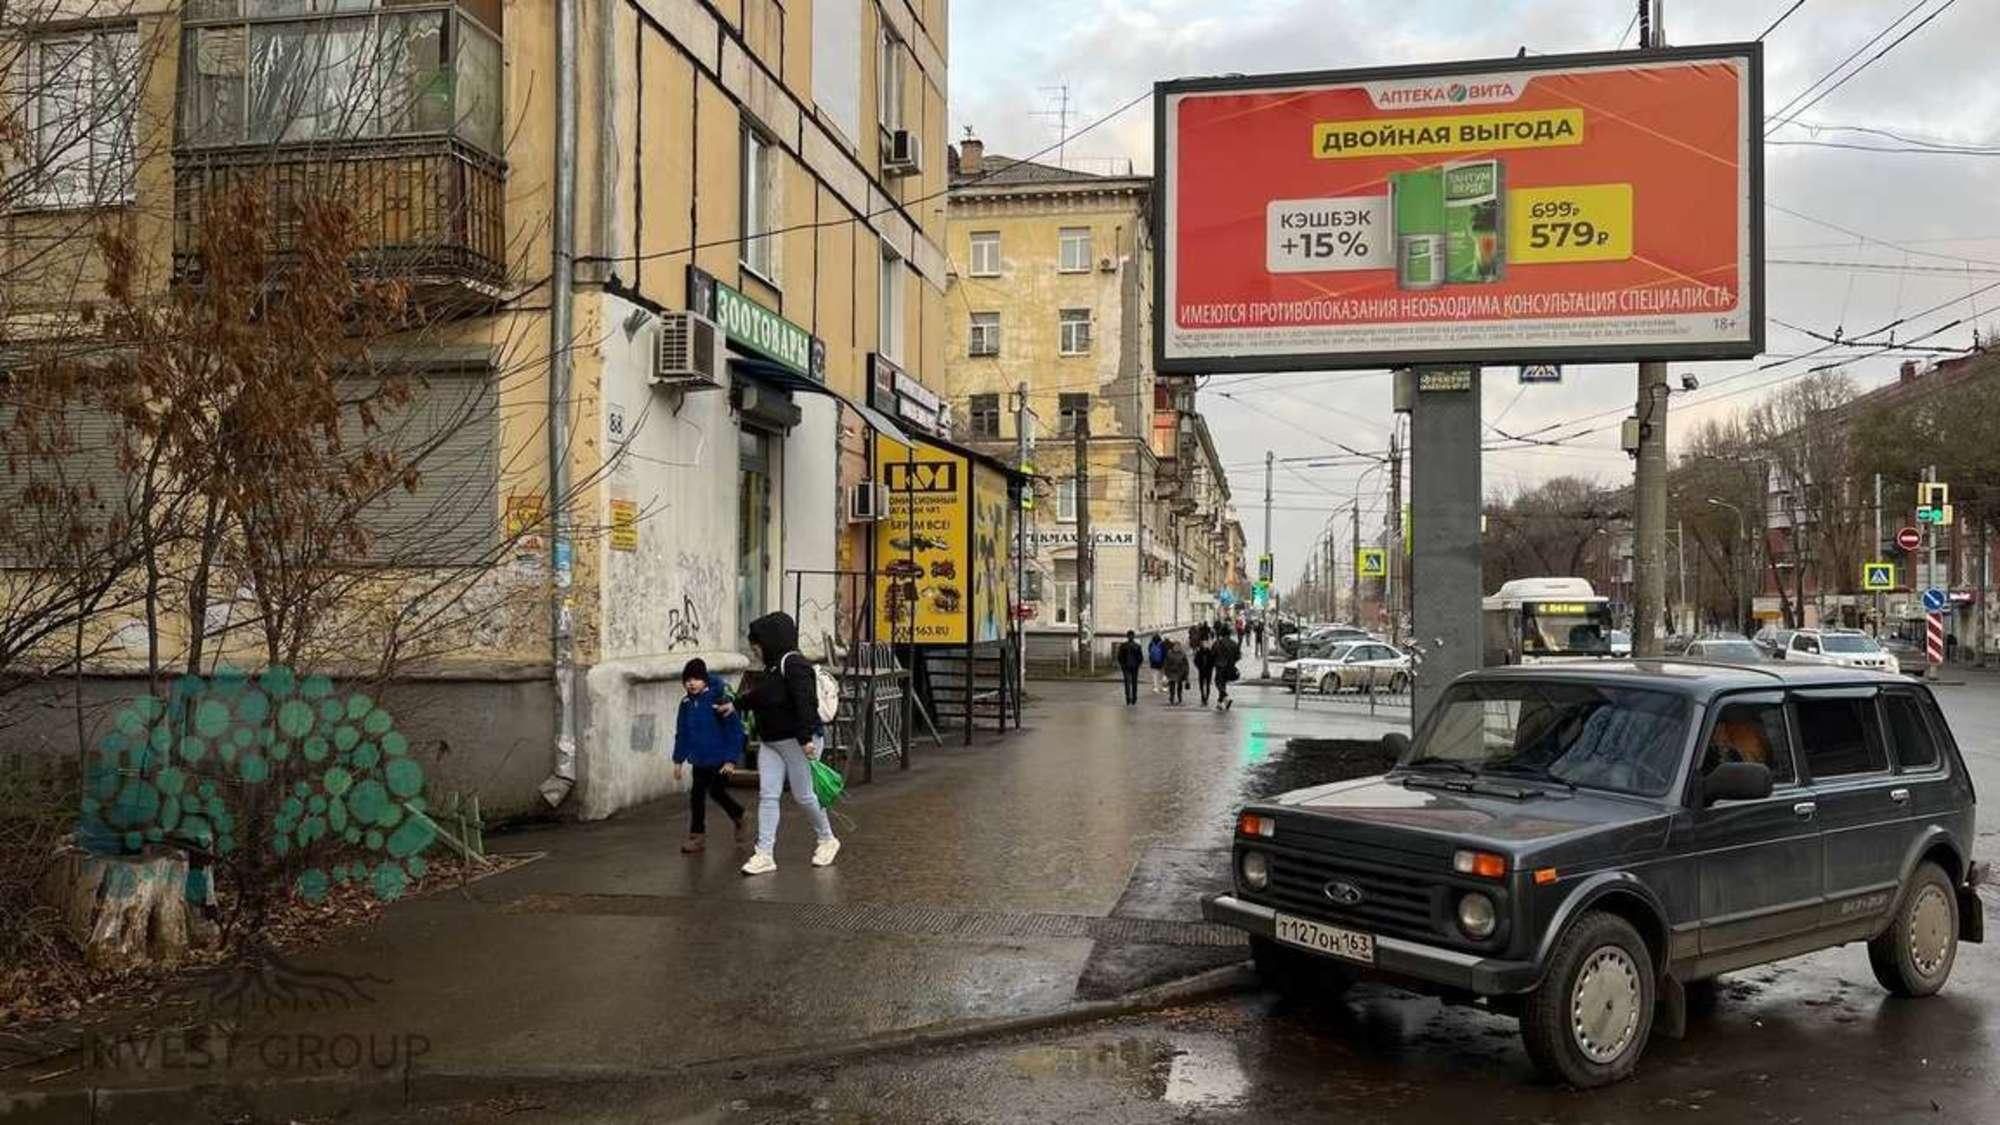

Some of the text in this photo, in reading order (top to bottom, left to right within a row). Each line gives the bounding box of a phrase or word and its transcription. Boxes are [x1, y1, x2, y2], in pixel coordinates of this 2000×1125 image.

[1380, 82, 1515, 104] АПТЕКА ВИТА
[1322, 118, 1574, 152] ДВОЙНАЯ ВЫГОДА
[1280, 209, 1372, 229] КЭШБЭК
[1280, 230, 1369, 258] +15%
[1180, 286, 1731, 325] ИМЕЮТСЯ ПРОТИВОПОКАЗАНИЯ НЕОБХОДИМА КОНСУЛЬТАЦИЯ СПЕЦИАЛИСТА
[717, 289, 810, 371] ЗООТОВАРЫ
[1713, 317, 1737, 331] 18+
